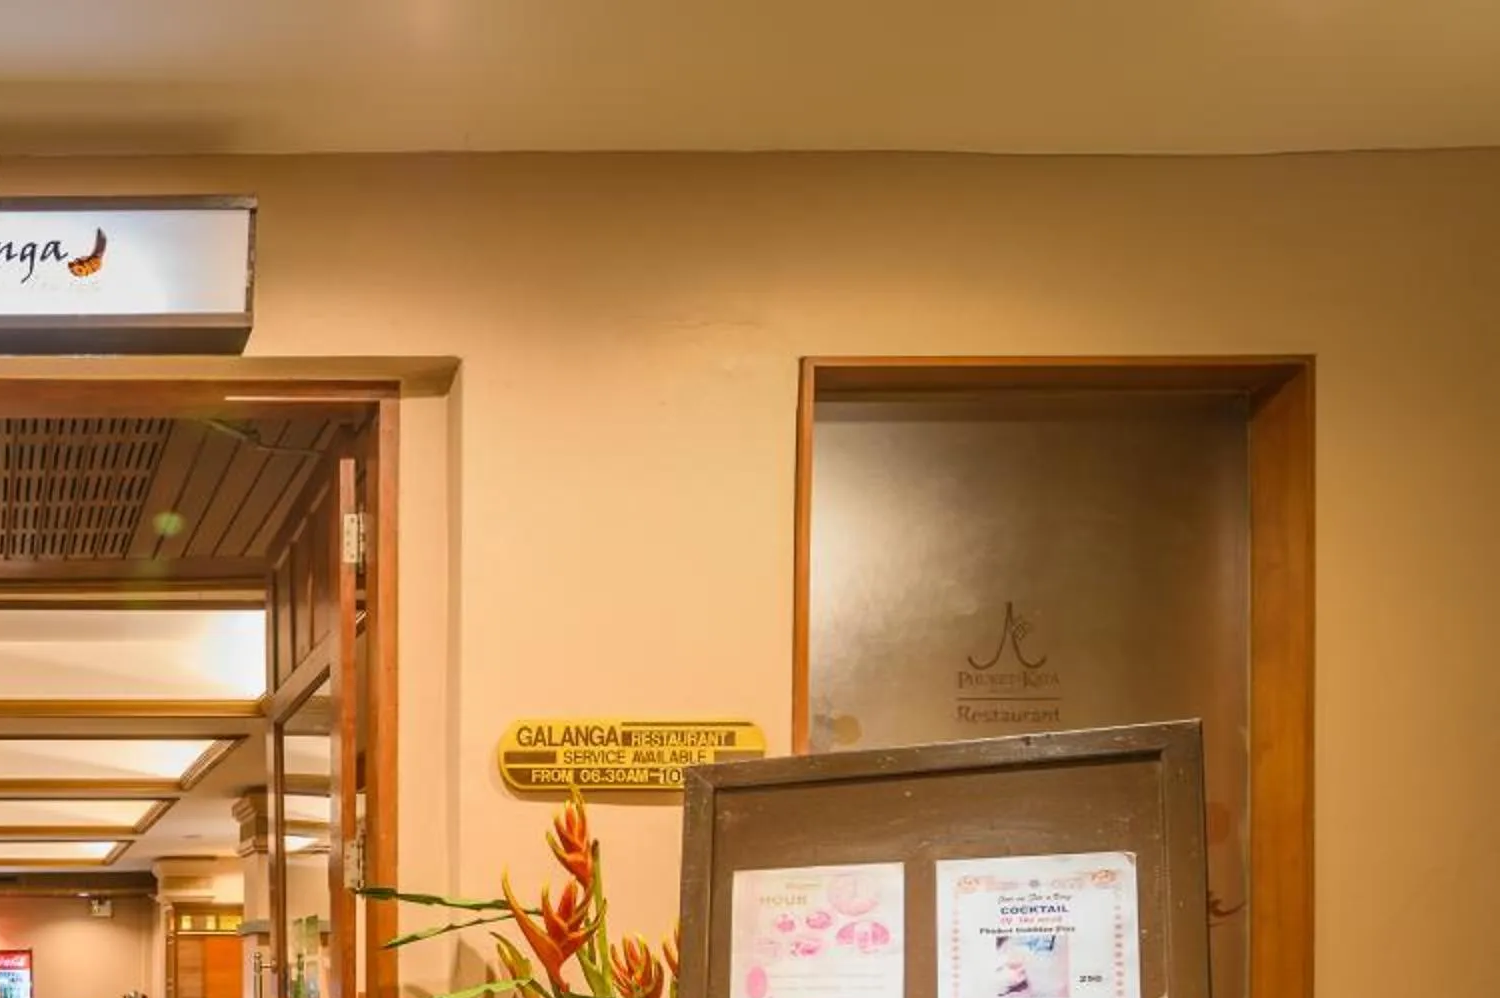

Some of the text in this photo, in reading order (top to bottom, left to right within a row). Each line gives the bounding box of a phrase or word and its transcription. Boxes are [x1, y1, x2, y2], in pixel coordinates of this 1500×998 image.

[955, 705, 1060, 723] Restaurant
[516, 726, 728, 748] GALANGA RESTAURANT
[563, 750, 706, 764] SERVICE AVAILABLE
[531, 770, 573, 783] FROM
[1000, 905, 1069, 915] COCKTAIL
